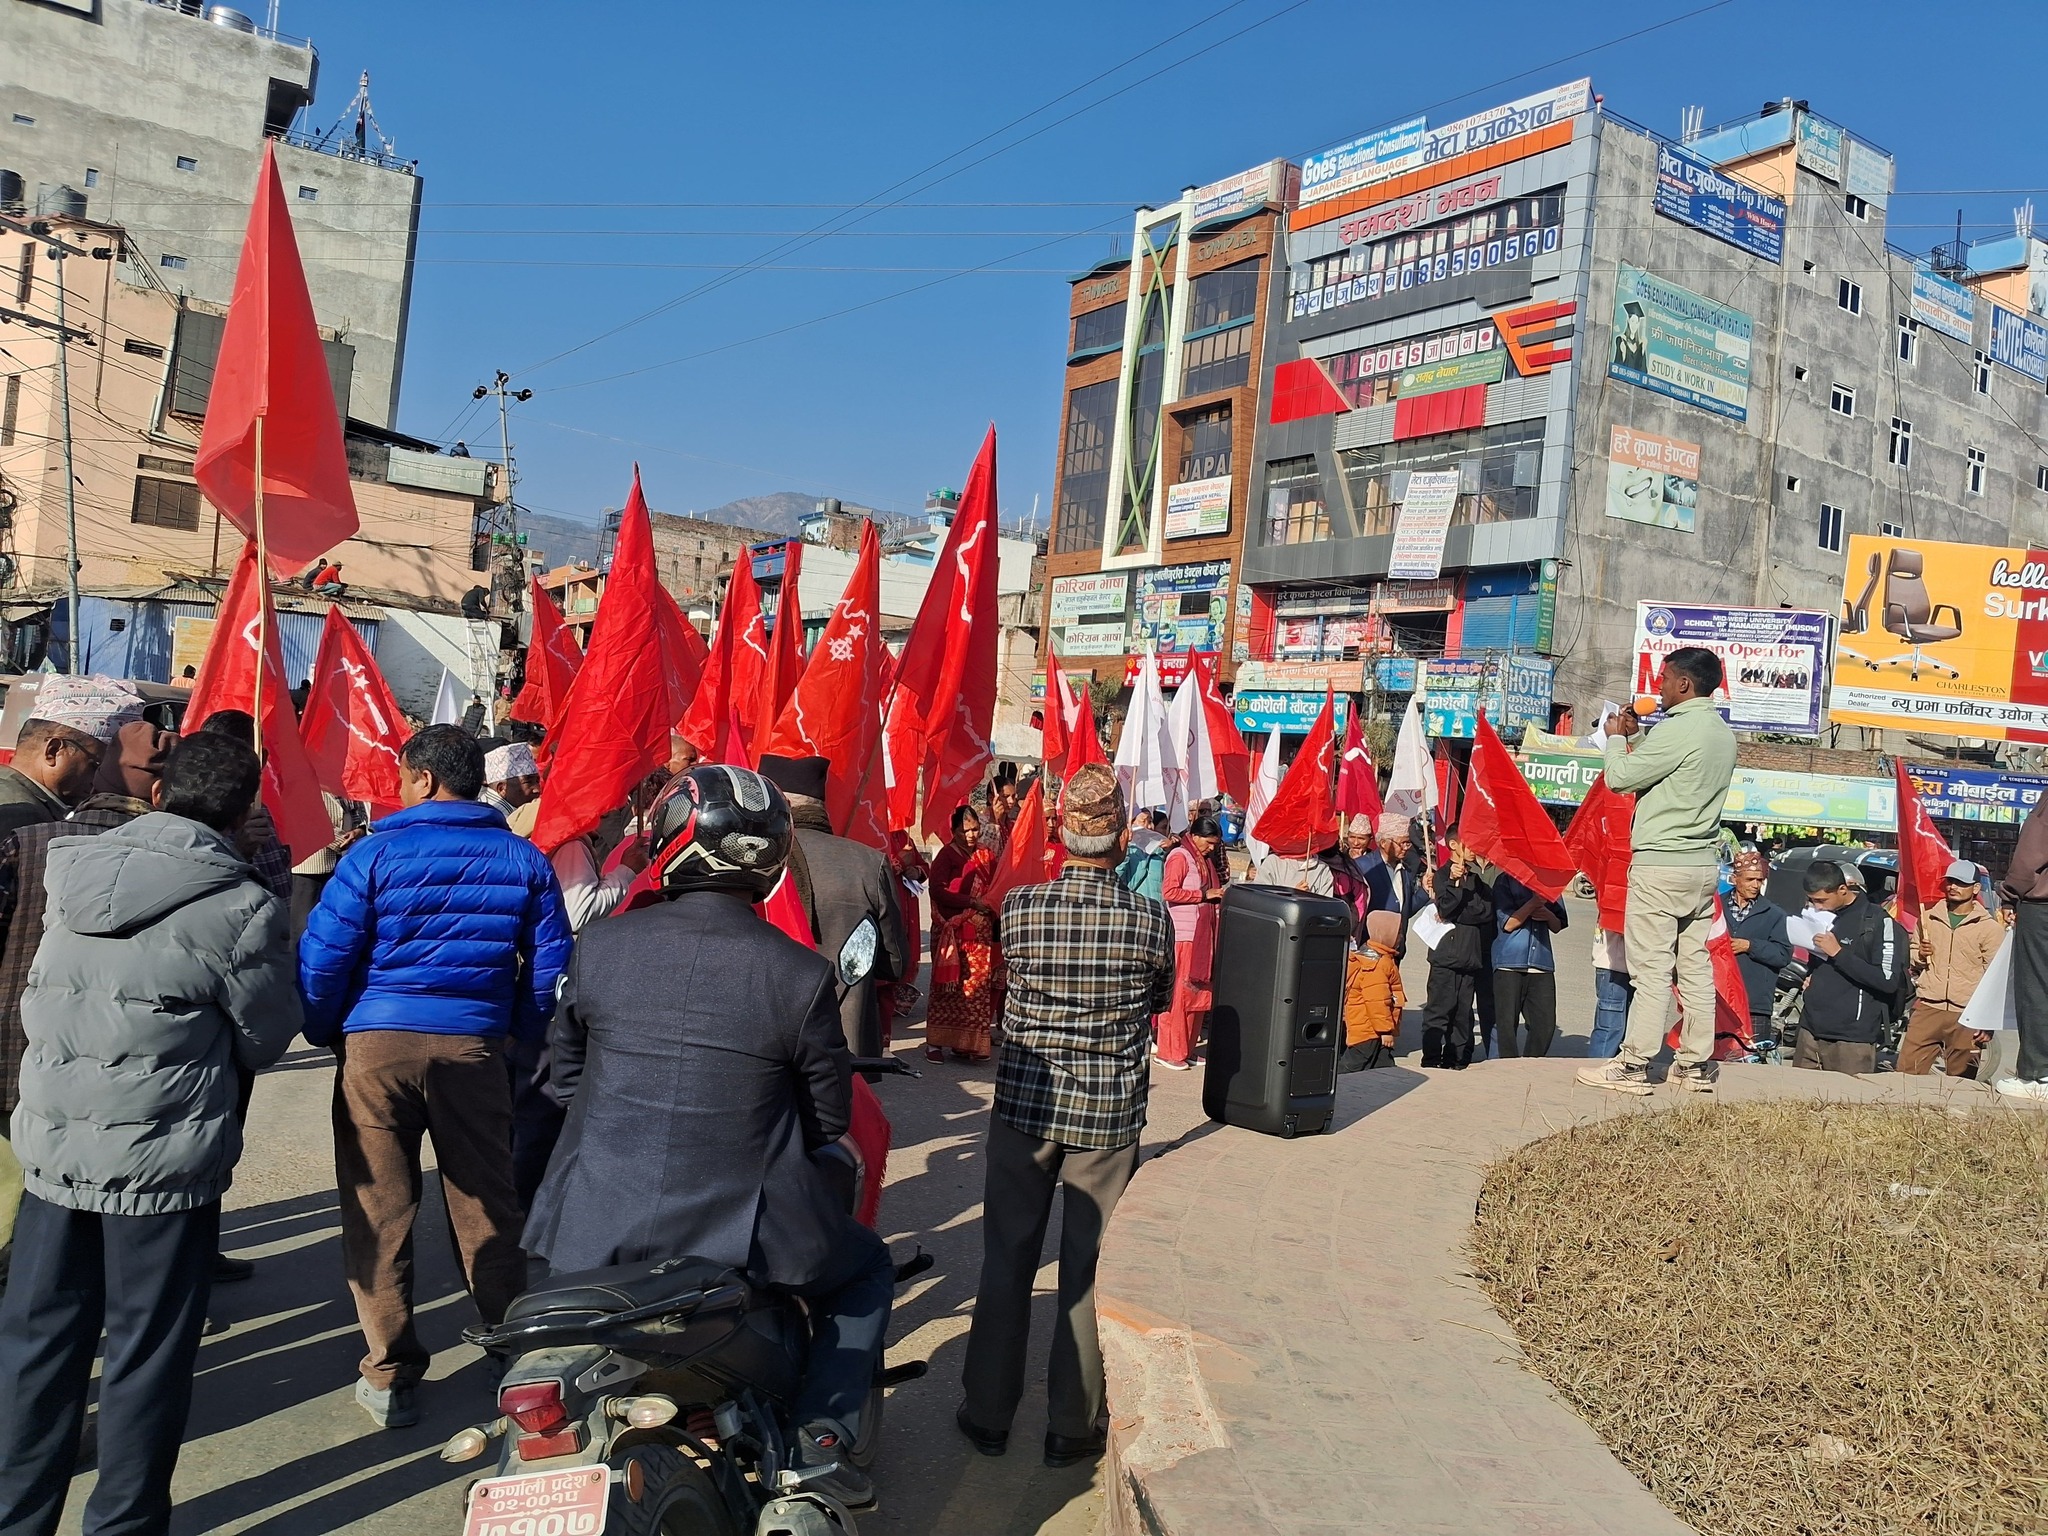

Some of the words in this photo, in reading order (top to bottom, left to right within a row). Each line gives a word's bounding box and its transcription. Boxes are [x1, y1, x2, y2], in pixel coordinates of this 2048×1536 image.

[1447, 106, 1506, 134] 9861074370
[1302, 156, 1338, 187] Goes
[1338, 140, 1377, 170] Educational
[1378, 131, 1422, 156] Consultancy
[1424, 133, 1460, 162] मेटा
[1307, 174, 1354, 198] JAPANESE
[1355, 156, 1409, 181] LANGUAGE
[1810, 155, 1836, 178] 한국어
[1194, 197, 1218, 218] Japanese
[1219, 188, 1243, 207] Language
[1437, 176, 1501, 216] भवन
[1685, 163, 1736, 204] एजुकेशन
[1735, 182, 1754, 210] Top
[1756, 192, 1784, 219] Floor
[1747, 211, 1760, 223] With
[1760, 217, 1777, 231] Hostel
[1197, 225, 1258, 262] COMPLEX
[1081, 279, 1121, 304] TIWARI
[1636, 281, 1651, 302] GOES
[1652, 286, 1688, 317] EDUCATIONAL
[1690, 302, 1727, 330] CONSULTANCY
[1694, 324, 1714, 341] Surkhet
[1996, 309, 2024, 367] HOTEL
[1362, 346, 1422, 373] GOES
[1427, 333, 1476, 361] जापान
[1706, 347, 1724, 363] भाषा
[1682, 353, 1698, 367] Direct
[1700, 359, 1714, 374] Apply
[1715, 364, 1728, 376] From
[1728, 369, 1748, 384] Surkhet
[2023, 352, 2045, 379] KOSHELI
[1651, 359, 1675, 378] STUDY
[1676, 369, 1683, 382] &
[1684, 371, 1706, 390] WORK
[1706, 380, 1714, 393] IN
[1717, 380, 1744, 404] JAPAN
[1613, 430, 1631, 455] हरे
[1633, 438, 1662, 461] कृष्ण
[1055, 578, 1097, 594] कोरियन
[1100, 577, 1125, 590] भाषा
[1277, 591, 1288, 601] हरे
[1398, 588, 1451, 600] EDUCATION
[1984, 592, 2048, 621] Surk
[1066, 632, 1099, 644] कोरियन
[1102, 633, 1122, 642] भाषा
[1684, 619, 1715, 628] SCHOOL
[1728, 622, 1784, 630] MANAGEMENT
[1785, 624, 1820, 633] (MUSOM)
[1729, 642, 1774, 659] Open
[1778, 644, 1806, 659] for
[1162, 658, 1188, 670] इन्टरप्रा
[1267, 666, 1279, 677] हरे
[1637, 652, 1731, 700] MA
[1508, 667, 1551, 697] HOTEL
[1936, 681, 2006, 695] CHARLESTON
[1250, 695, 1287, 714] कोशेली
[1427, 693, 1468, 710] कोशेली
[1508, 694, 1549, 708] कोशेली
[1848, 699, 1870, 708] Dealer
[1849, 691, 1886, 701] Authorized
[1891, 698, 1911, 713] न्यू
[1915, 699, 1939, 713] प्रभा
[1524, 758, 1579, 785] पंगाली
[1742, 776, 1755, 784] pay
[1947, 780, 2017, 802] मोबाईल
[2020, 788, 2043, 804] हा
[489, 1478, 548, 1500] कर्णाली
[551, 1473, 589, 1493] प्रदेश
